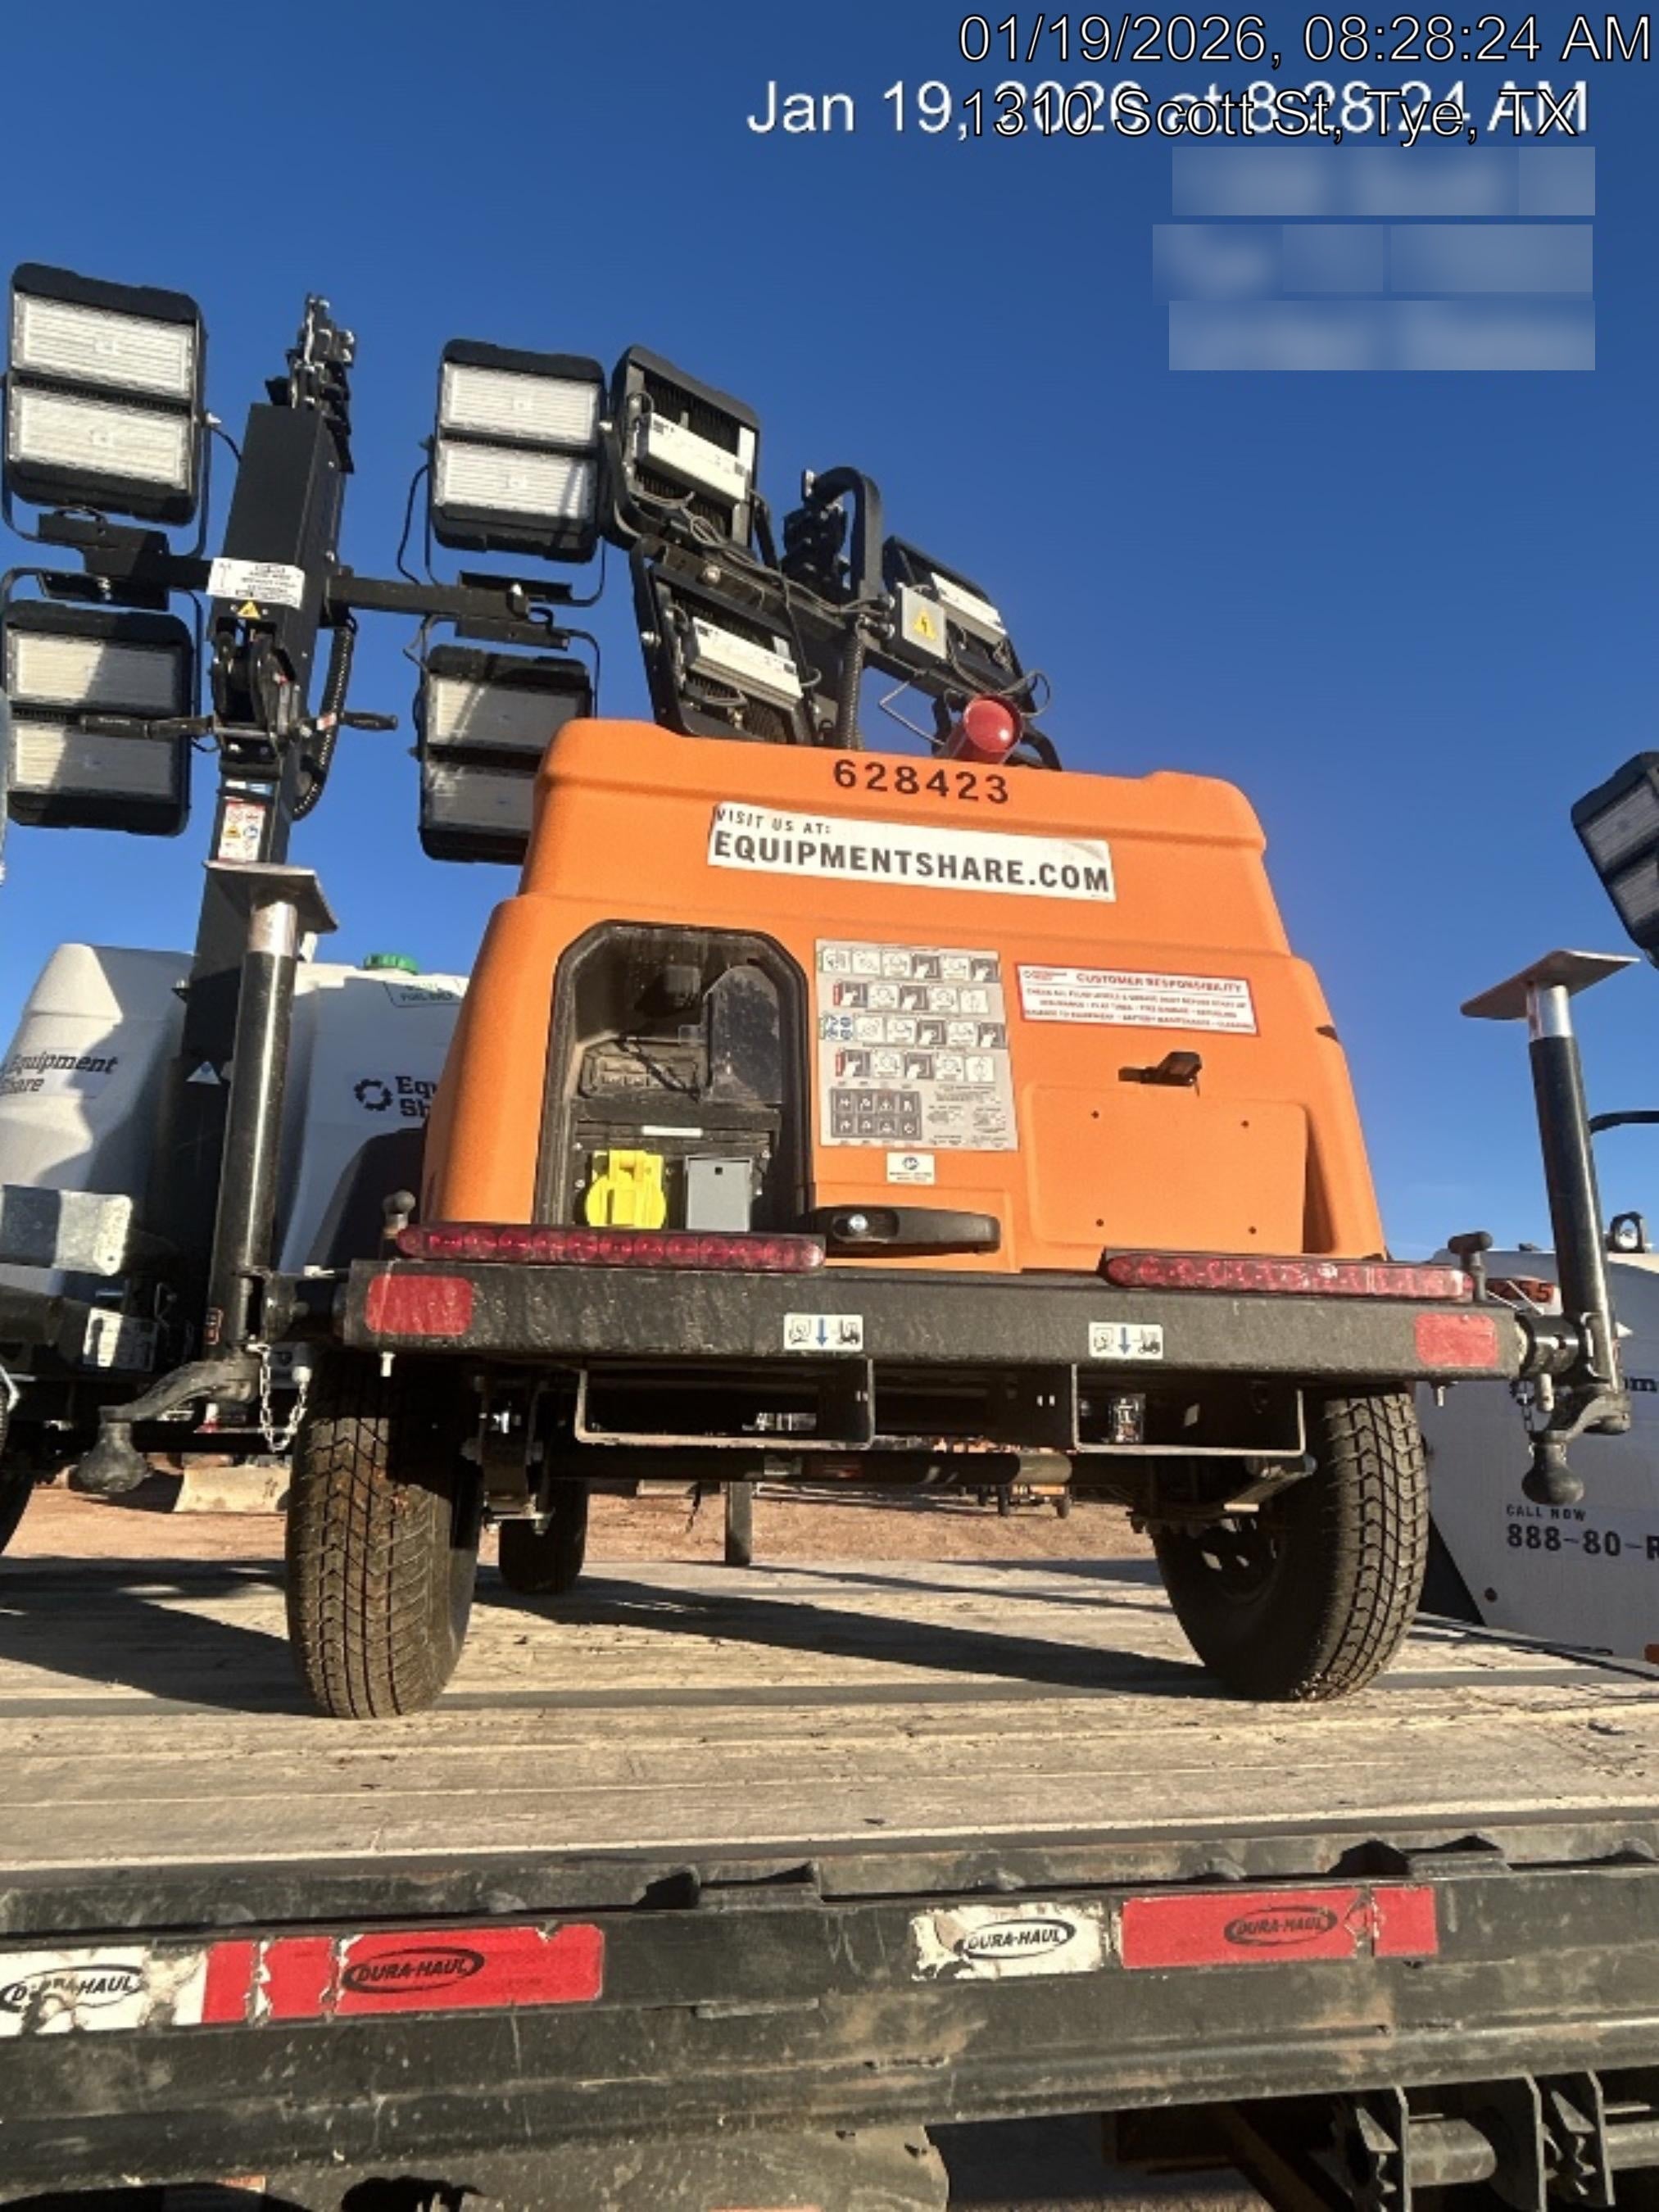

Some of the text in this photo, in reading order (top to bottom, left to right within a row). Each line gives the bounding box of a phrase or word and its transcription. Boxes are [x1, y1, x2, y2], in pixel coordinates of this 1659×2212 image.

[833, 759, 1010, 805] 628423
[716, 808, 832, 834] VISIT US AT:
[714, 829, 1110, 893] EQUIPMENTSHARE.COM
[1506, 1503, 1586, 1521] CALL NOW
[968, 1928, 1060, 1950] DURA-HAUL
[357, 1957, 468, 1982] DURA-HAUL
[11, 1974, 133, 2001] DRA-HAUL
